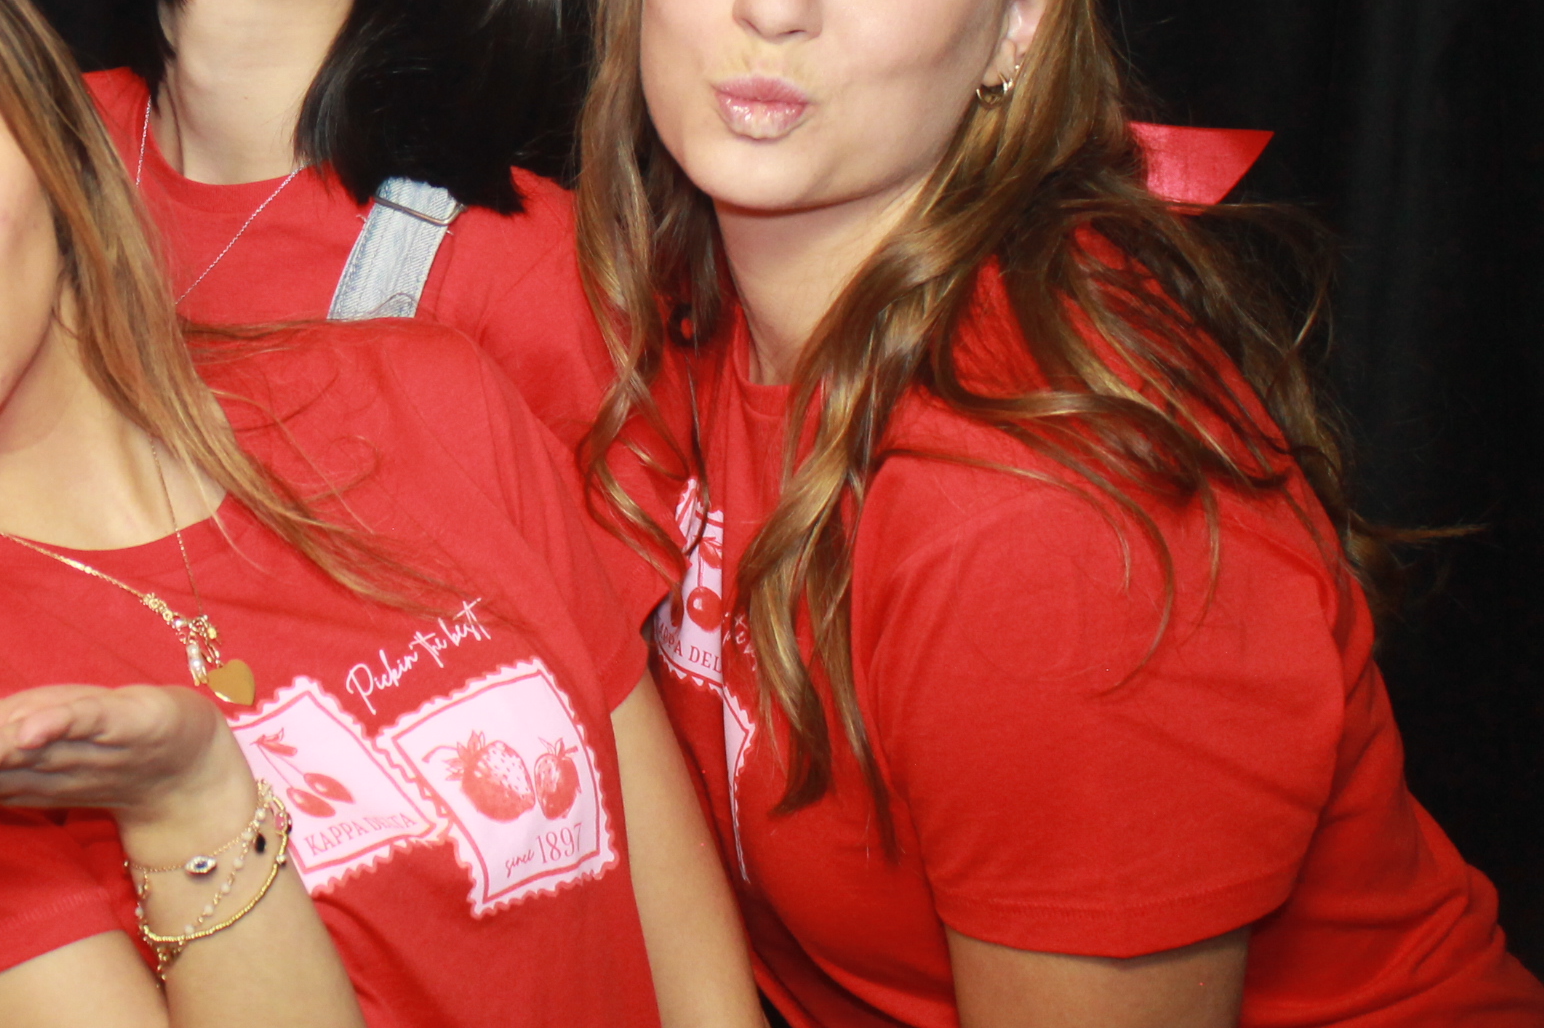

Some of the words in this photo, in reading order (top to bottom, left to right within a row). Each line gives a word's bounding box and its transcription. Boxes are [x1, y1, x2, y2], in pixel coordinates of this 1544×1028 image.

[409, 630, 448, 669] the
[437, 597, 492, 647] best
[303, 819, 370, 857] KAPPA
[505, 848, 536, 879] since
[535, 821, 583, 864] 1897
